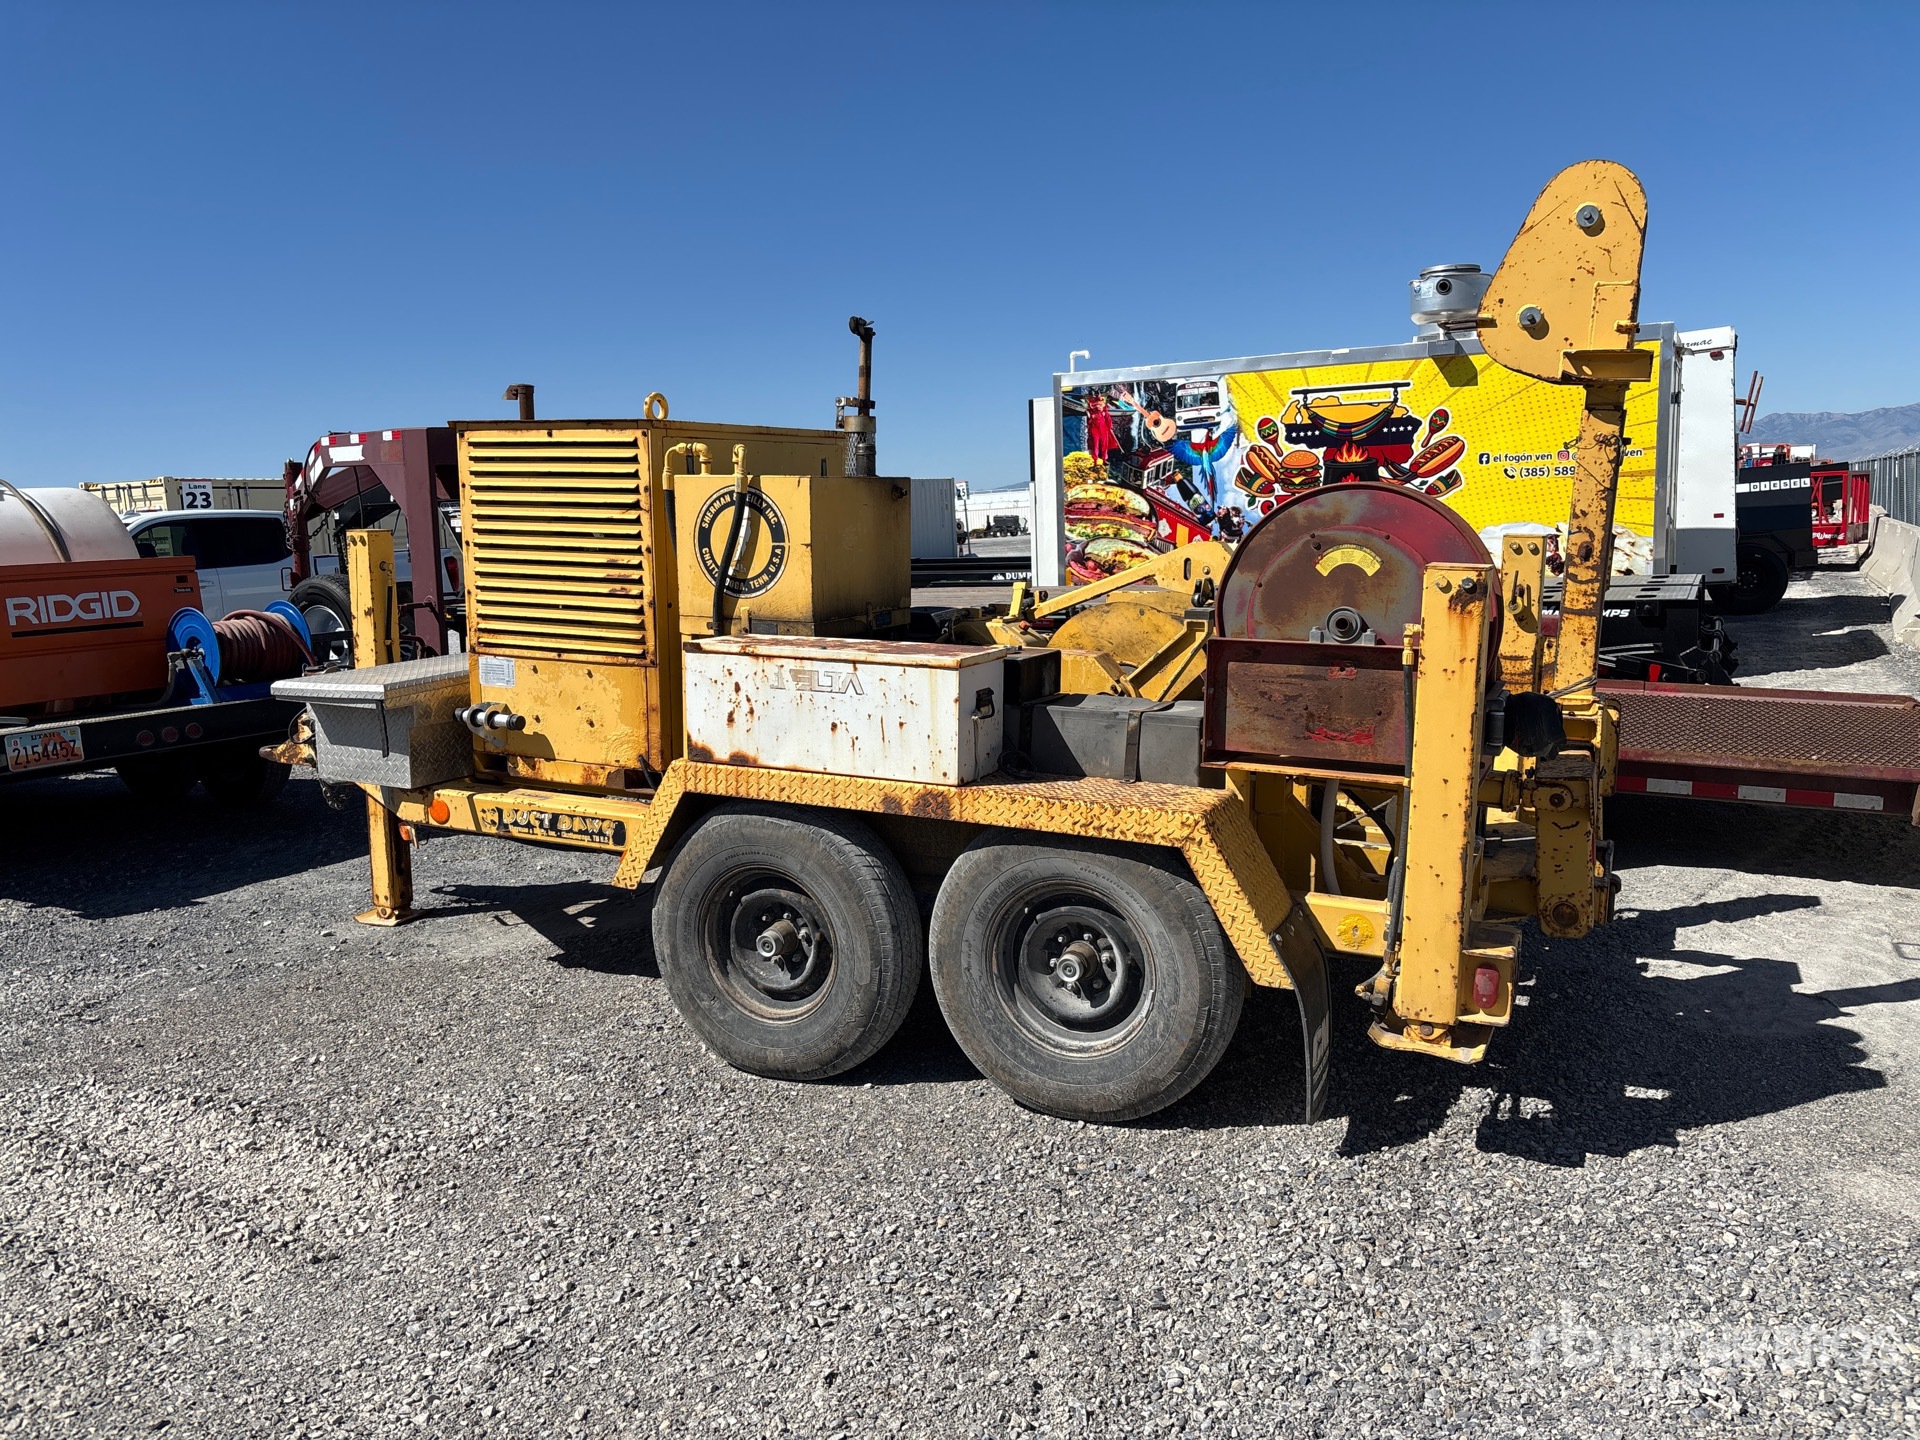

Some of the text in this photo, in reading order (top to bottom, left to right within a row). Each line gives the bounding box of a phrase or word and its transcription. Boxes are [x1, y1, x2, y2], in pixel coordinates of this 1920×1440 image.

[1683, 339, 1713, 348] rmac
[1493, 453, 1553, 464] el fogón ven
[1519, 467, 1551, 478] (385)
[1752, 481, 1808, 490] DIESEL
[185, 491, 212, 509] 23
[701, 493, 732, 529] SHERMAN
[745, 493, 767, 510] EILLY
[764, 507, 778, 528] INC.
[701, 547, 749, 592] CHATTOOGA,
[749, 573, 772, 590] TENN.
[6, 590, 140, 626] RIDGID
[1602, 609, 1631, 618] MPS
[30, 732, 56, 741] UTAH
[503, 808, 553, 829] DUCT
